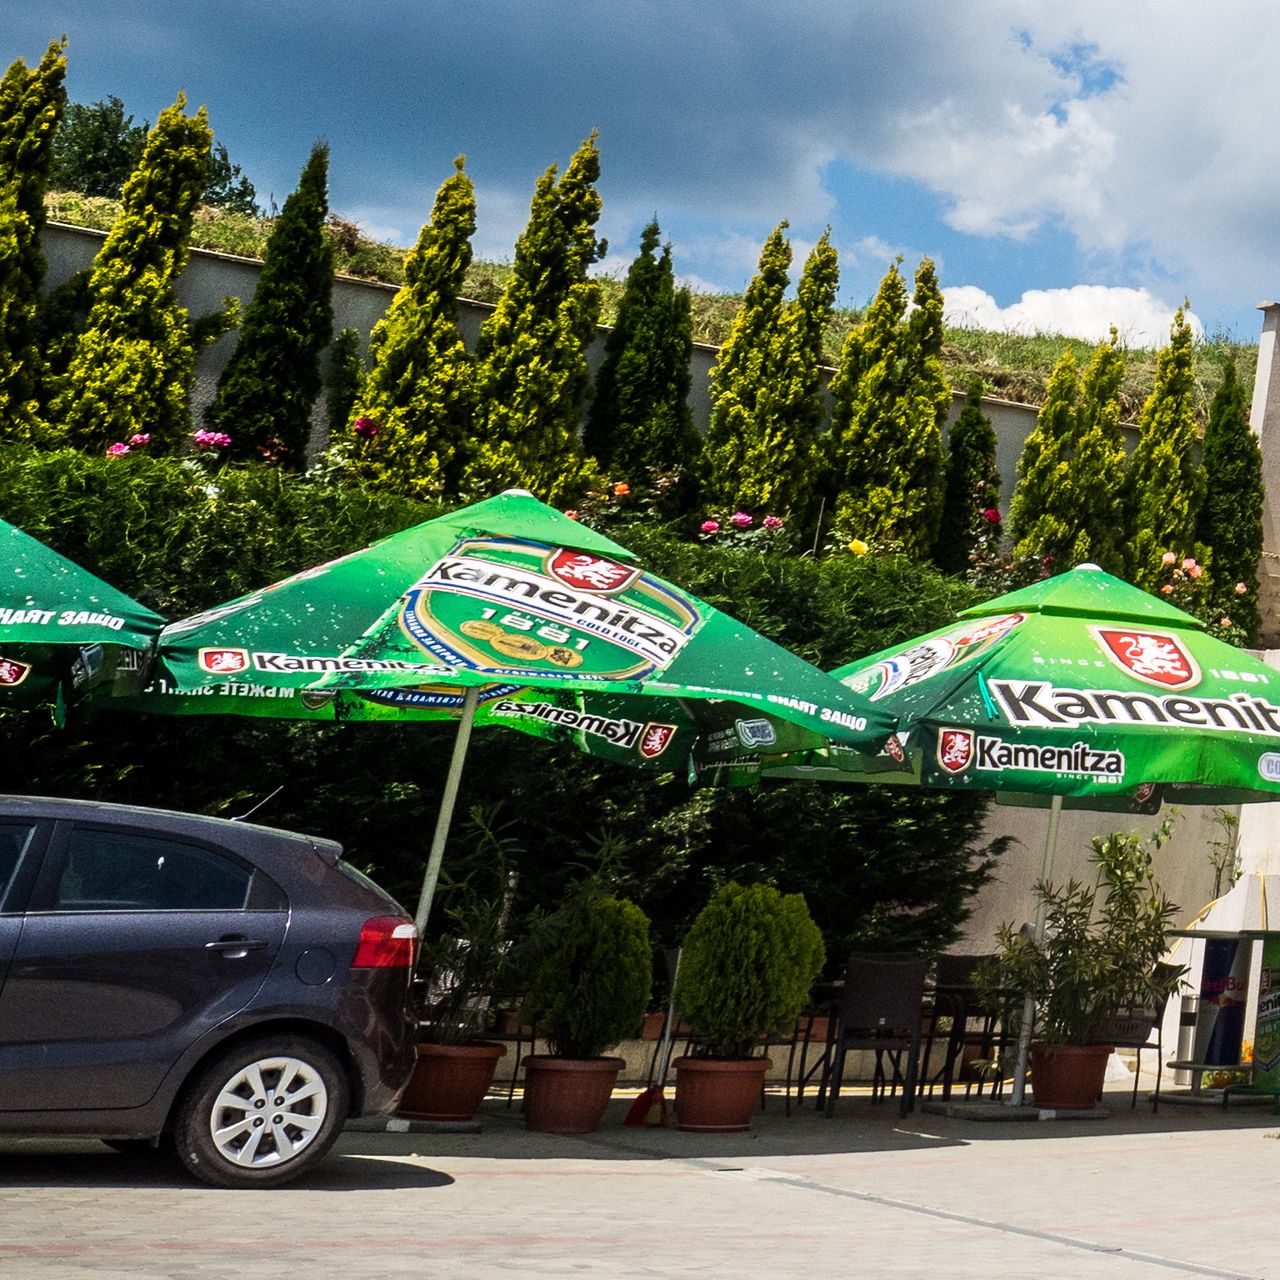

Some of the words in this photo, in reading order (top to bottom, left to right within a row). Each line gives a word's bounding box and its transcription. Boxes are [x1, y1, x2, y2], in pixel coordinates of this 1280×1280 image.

[57, 610, 126, 631] ЗАЩО
[427, 560, 679, 656] Kamenitza
[481, 607, 591, 651] 1881
[576, 618, 611, 637] COLD
[612, 631, 643, 649] EDGE
[1033, 656, 1106, 668] SINCE
[820, 707, 868, 732] ЗАЩО
[978, 738, 1123, 774] Kamenitza
